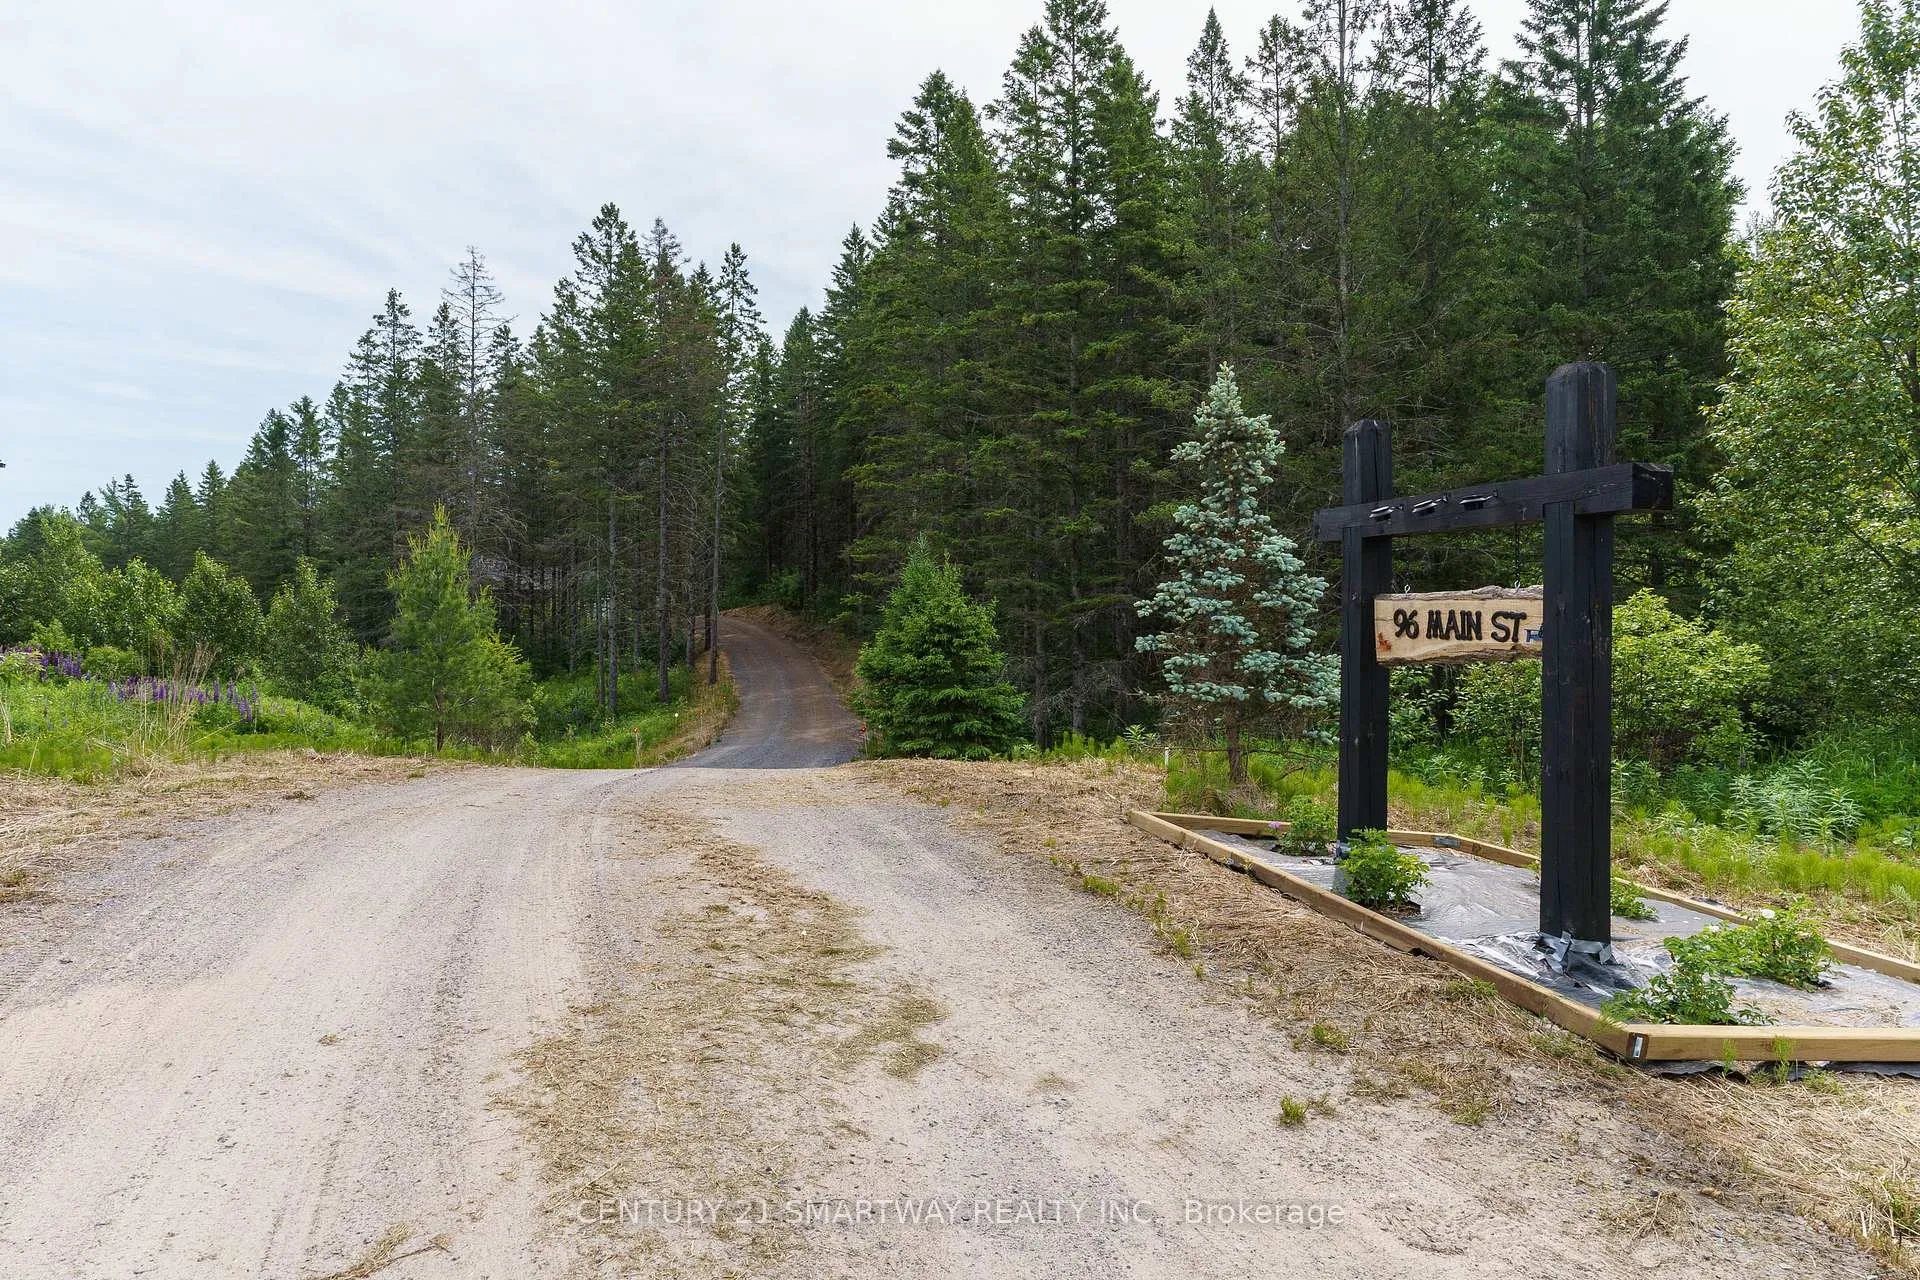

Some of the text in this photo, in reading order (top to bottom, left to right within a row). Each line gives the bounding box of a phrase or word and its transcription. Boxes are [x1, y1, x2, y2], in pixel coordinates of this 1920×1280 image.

[1393, 609, 1527, 643] 96 MAIN ST
